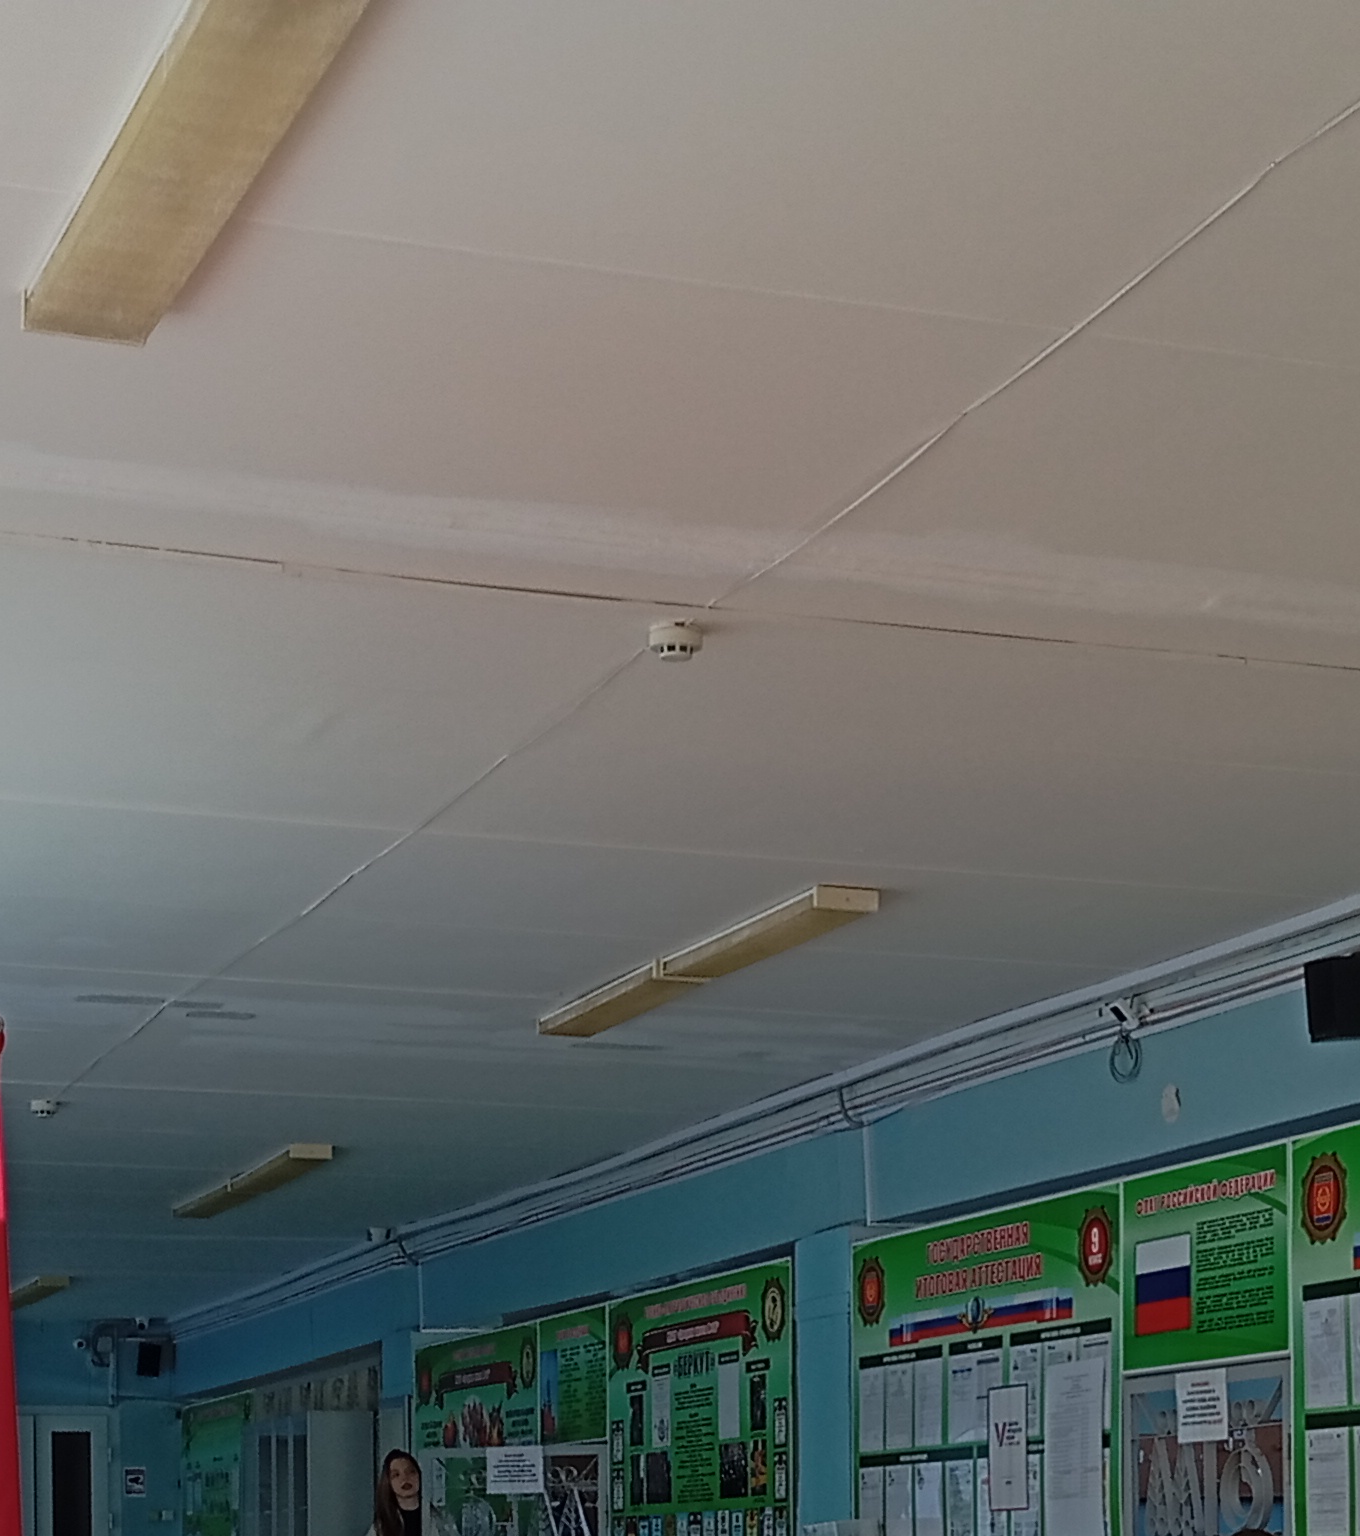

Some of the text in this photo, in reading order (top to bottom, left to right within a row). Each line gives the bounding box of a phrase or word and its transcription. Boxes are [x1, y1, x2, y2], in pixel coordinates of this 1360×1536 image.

[1159, 1178, 1218, 1209] РОССИЙСКОЙ
[1219, 1169, 1277, 1201] ФЕДЕРАЦИИ
[926, 1221, 1030, 1265] ГОСУДАРСТВЕННАЯ
[1090, 1227, 1099, 1253] 9
[915, 1252, 1043, 1299] ИТОГОВАЯ АТТЕСТАЦИЯ
